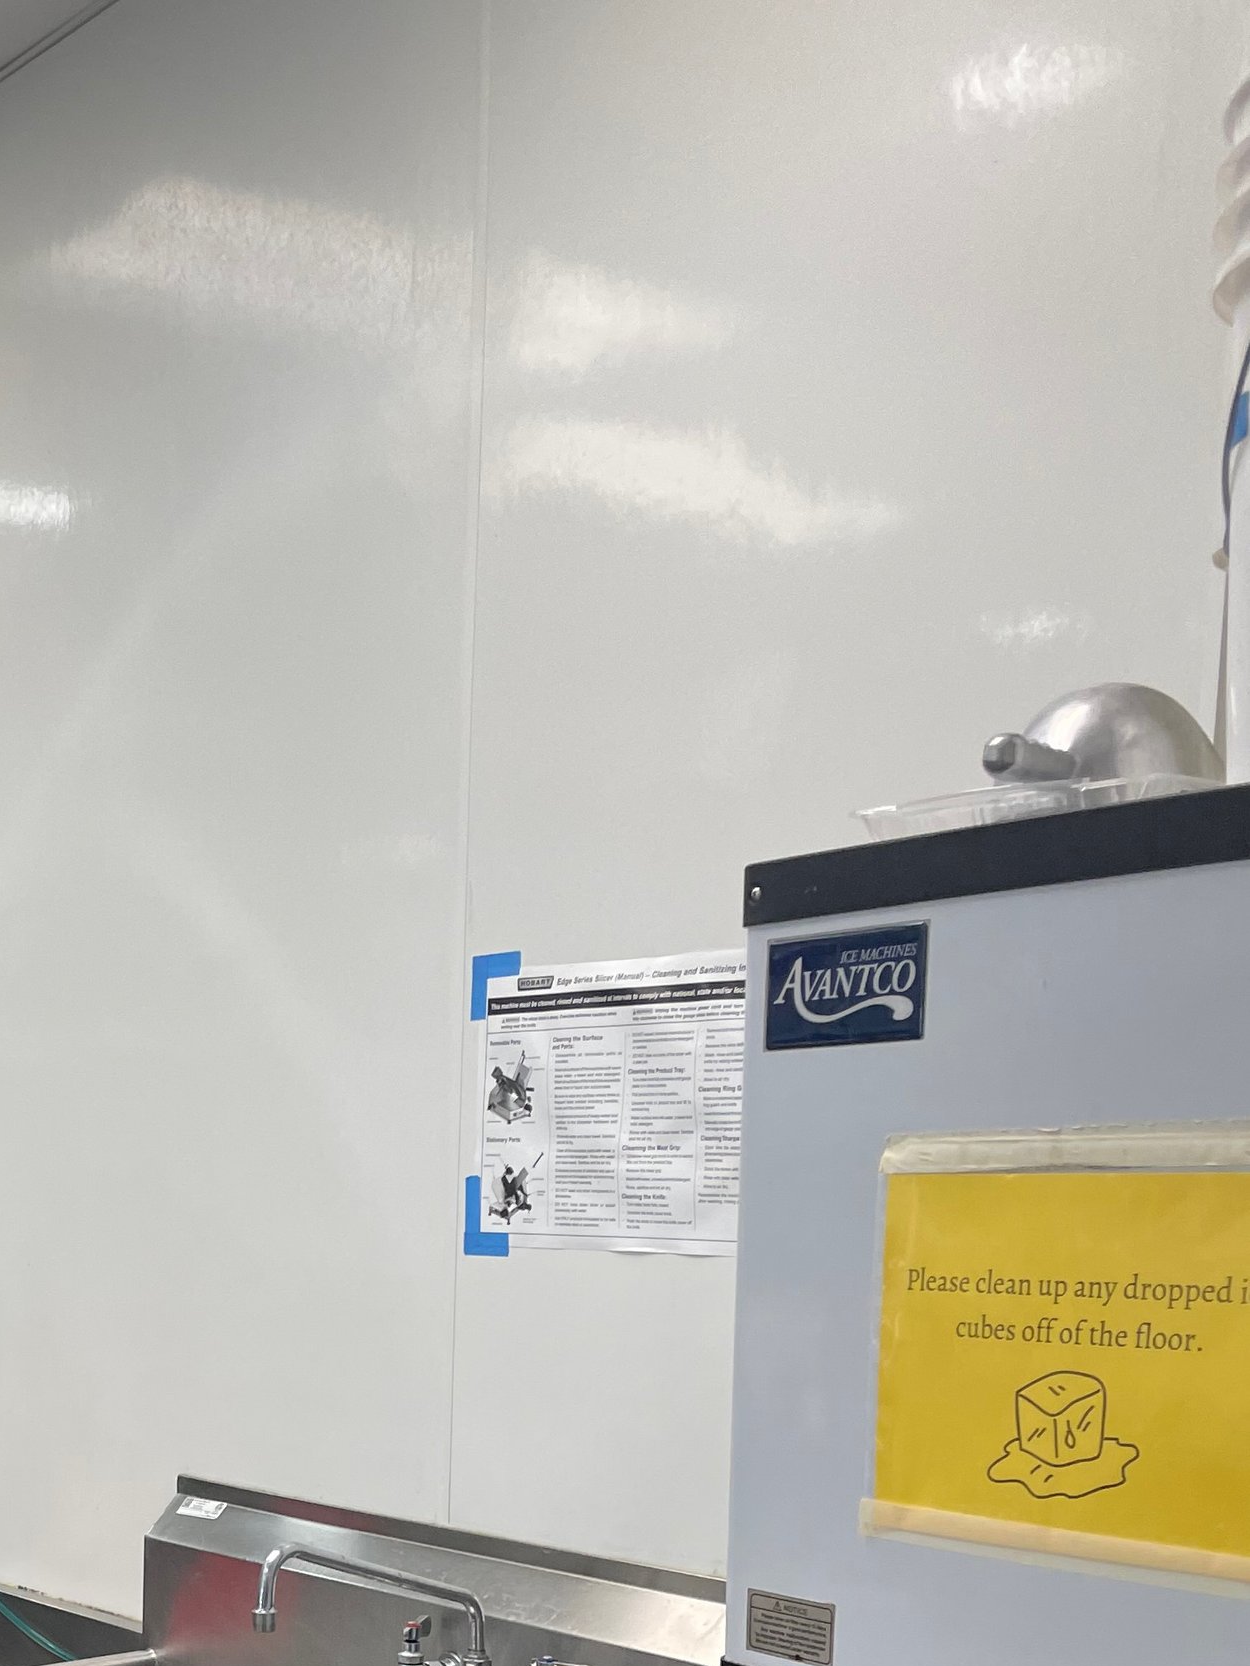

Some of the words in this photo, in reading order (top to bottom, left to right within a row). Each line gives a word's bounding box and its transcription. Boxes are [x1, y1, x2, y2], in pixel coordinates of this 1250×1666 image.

[839, 949, 858, 964] ICE
[859, 943, 918, 962] MACHINES
[519, 978, 551, 988] HOBART
[557, 977, 572, 987] Edge
[573, 975, 593, 985] Series
[652, 970, 682, 978] Cleaning
[683, 967, 698, 976] and
[699, 965, 737, 975] Sanitizing
[773, 956, 917, 1023] AVANTCO
[907, 1267, 970, 1292] Please
[976, 1269, 1031, 1296] clean
[1039, 1279, 1068, 1304] up
[1074, 1280, 1118, 1306] any
[1124, 1273, 1233, 1310] dropped
[1240, 1278, 1250, 1304] i
[956, 1314, 1016, 1341] cubes
[1022, 1317, 1059, 1343] off
[1059, 1319, 1088, 1345] of
[1089, 1320, 1128, 1347] the
[1135, 1322, 1203, 1351] floor.
[783, 1604, 808, 1616] NOTICE
